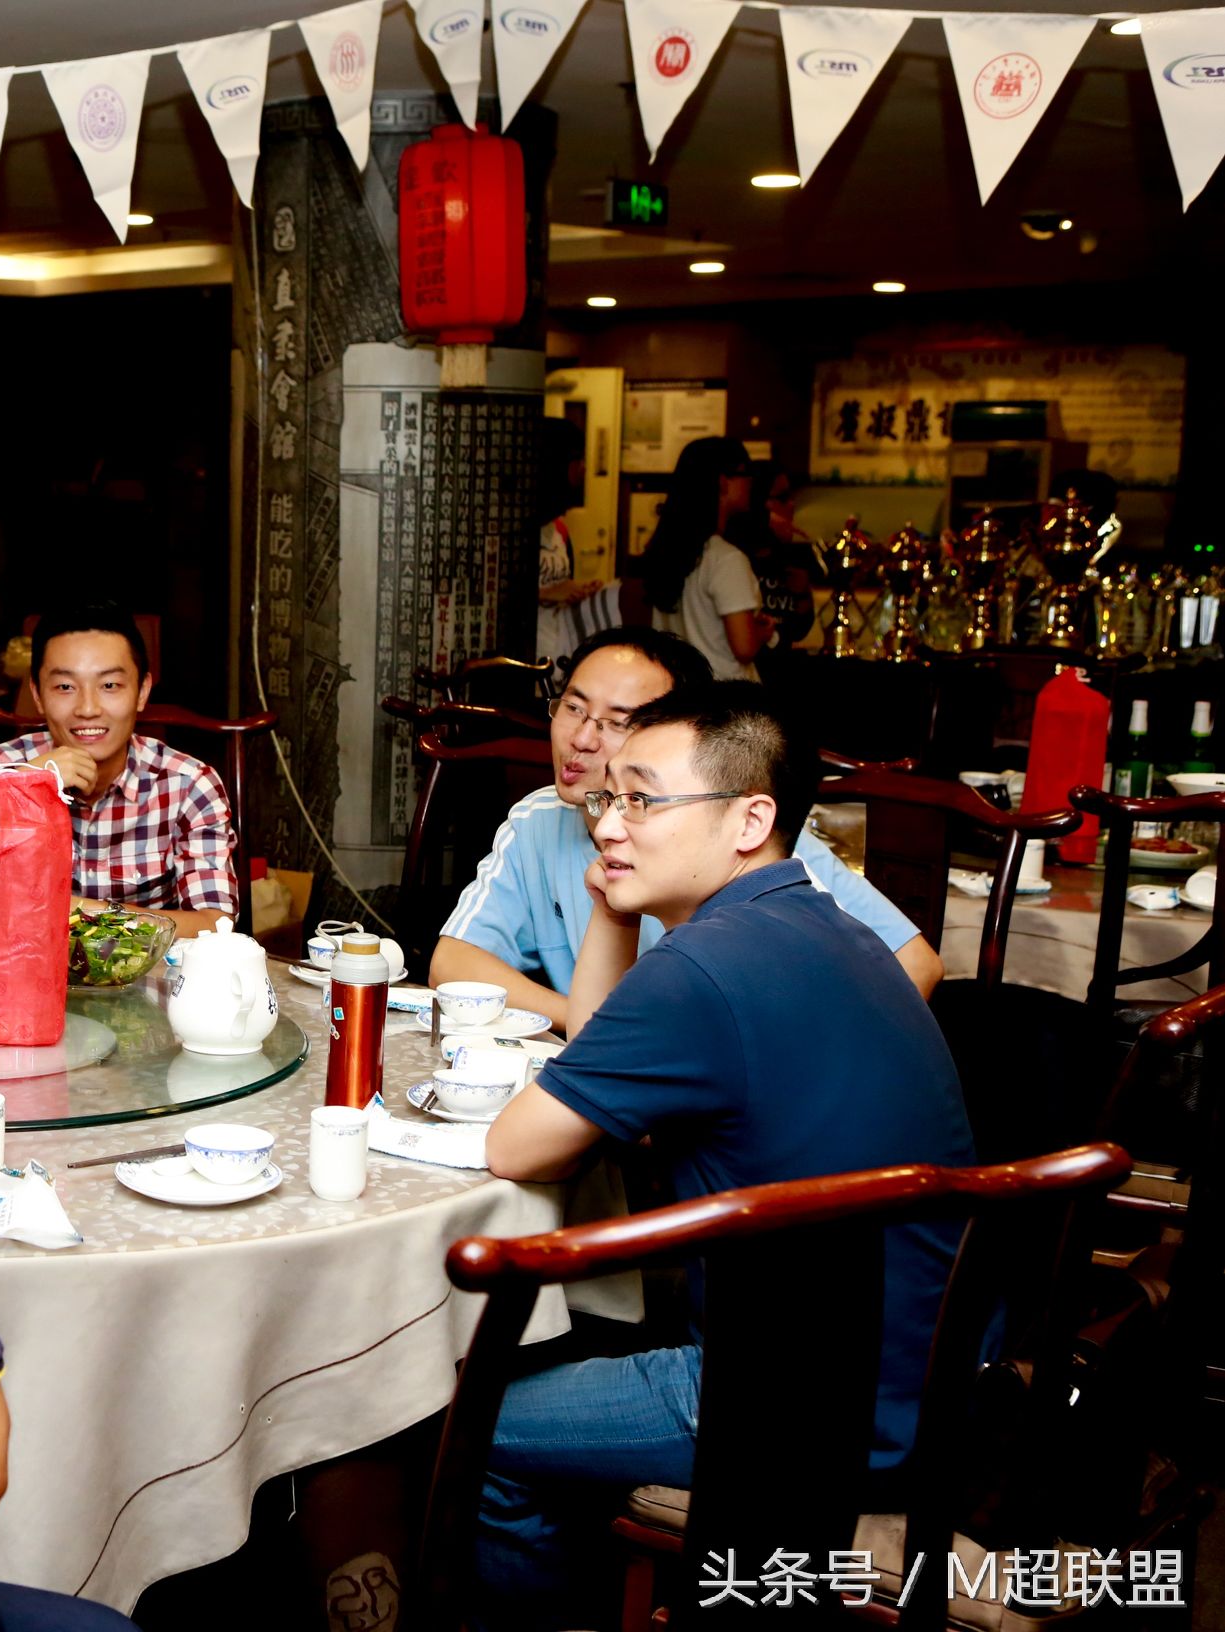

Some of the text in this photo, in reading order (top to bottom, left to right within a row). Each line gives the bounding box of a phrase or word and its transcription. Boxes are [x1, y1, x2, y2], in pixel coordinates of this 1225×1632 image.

[267, 493, 294, 698] 能吃的博物館
